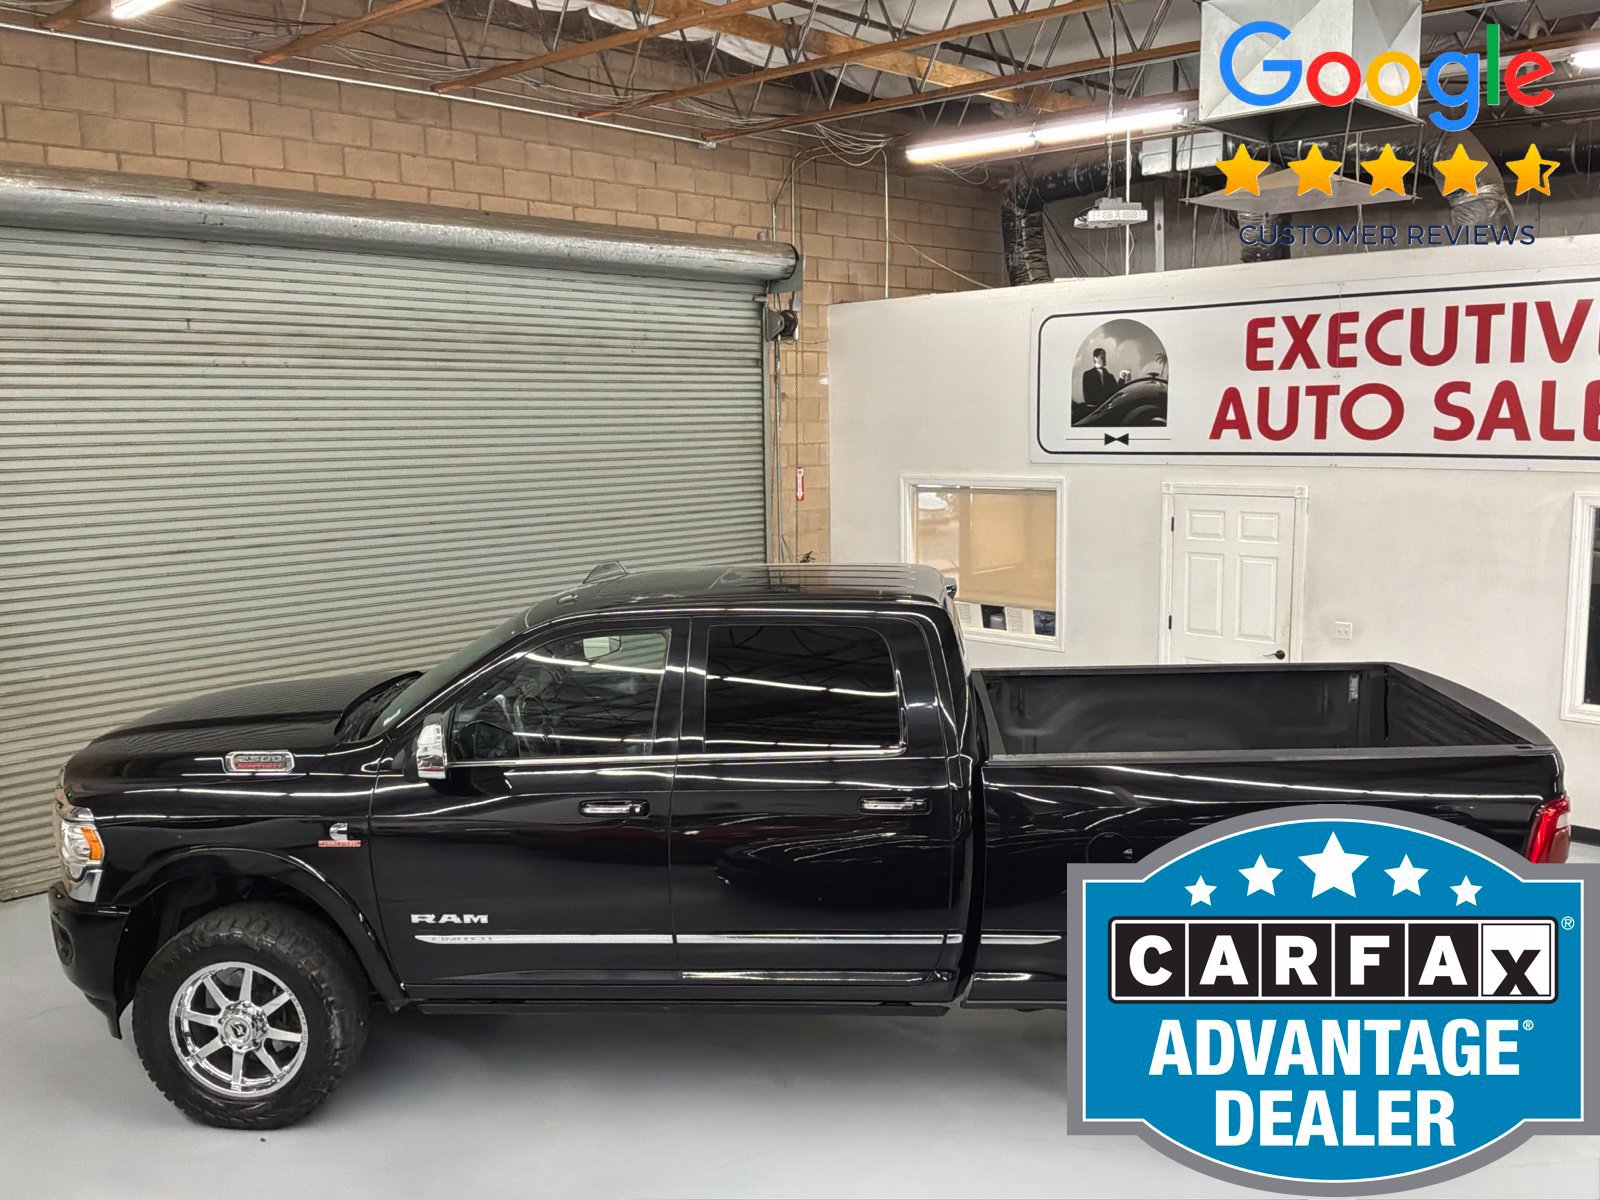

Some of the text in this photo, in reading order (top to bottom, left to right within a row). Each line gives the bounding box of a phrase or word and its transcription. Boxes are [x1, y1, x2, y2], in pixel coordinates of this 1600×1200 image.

[1246, 299, 1600, 371] EXECUTIV
[1209, 383, 1404, 441] AUTO
[410, 913, 489, 924] RAM
